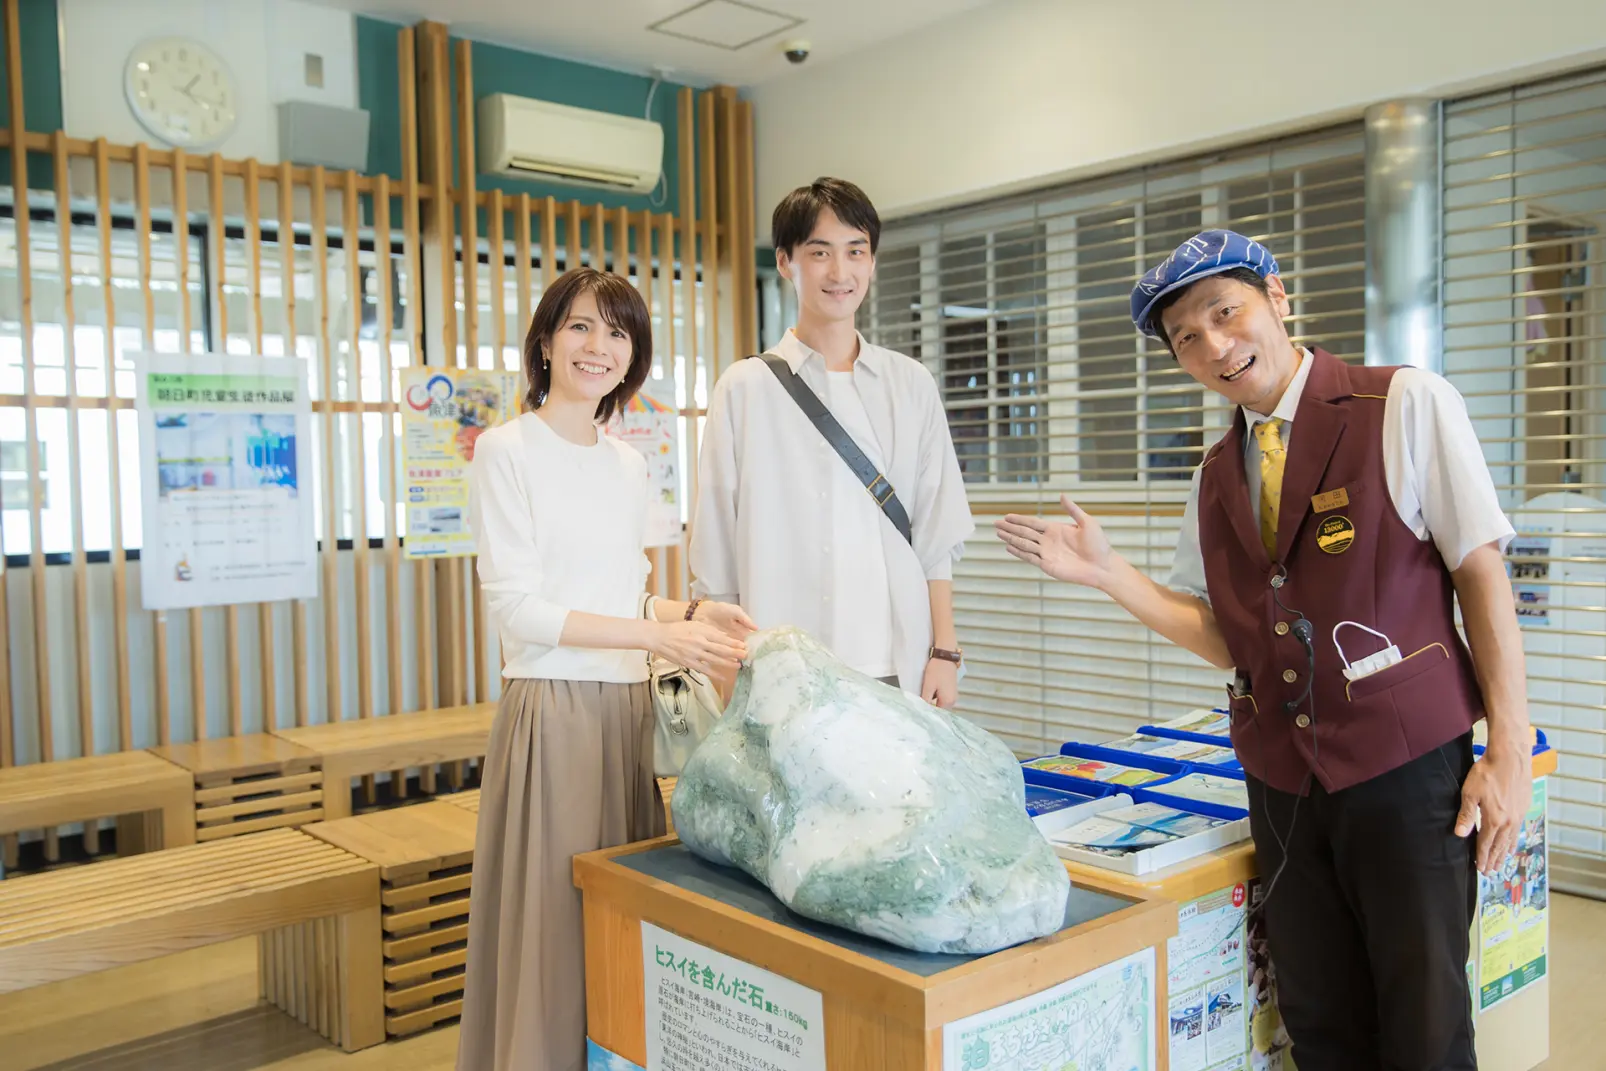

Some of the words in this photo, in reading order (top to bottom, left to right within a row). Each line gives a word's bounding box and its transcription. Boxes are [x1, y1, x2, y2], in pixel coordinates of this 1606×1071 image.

[656, 944, 765, 1011] ヒスイを含んだ石
